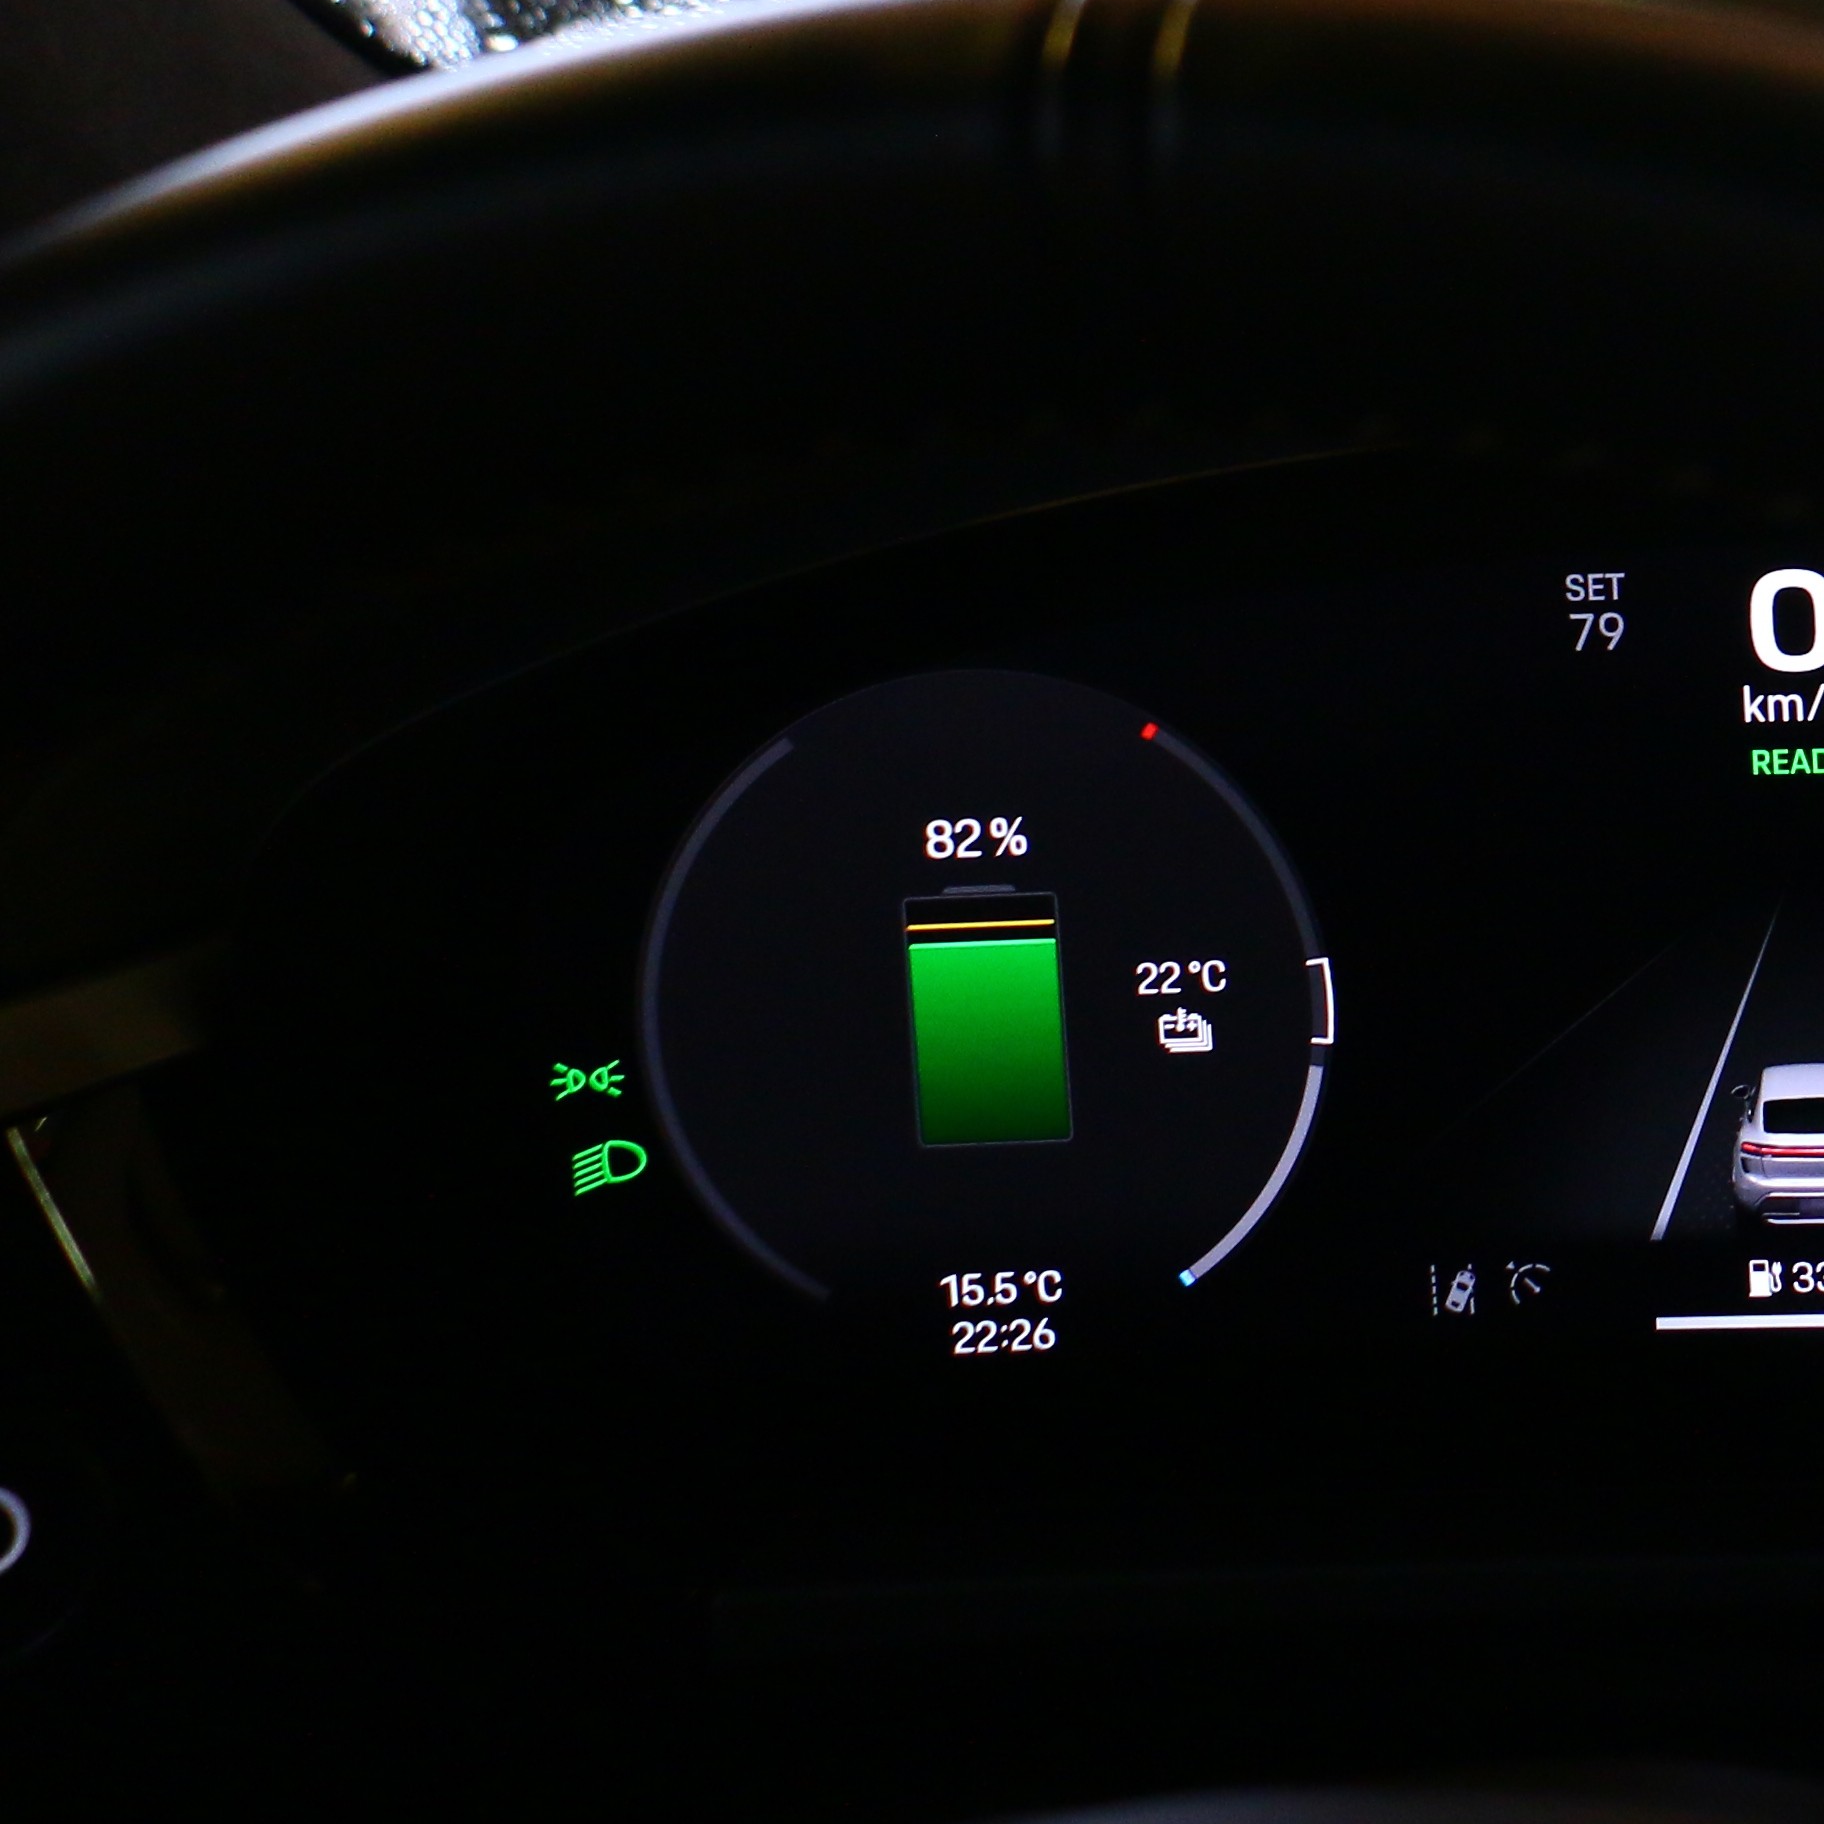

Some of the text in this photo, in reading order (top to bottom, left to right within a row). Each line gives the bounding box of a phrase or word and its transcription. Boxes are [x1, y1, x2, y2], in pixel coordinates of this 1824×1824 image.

[1565, 572, 1626, 602] SET
[1569, 611, 1625, 652] 79
[951, 1316, 1057, 1355] 22:26
